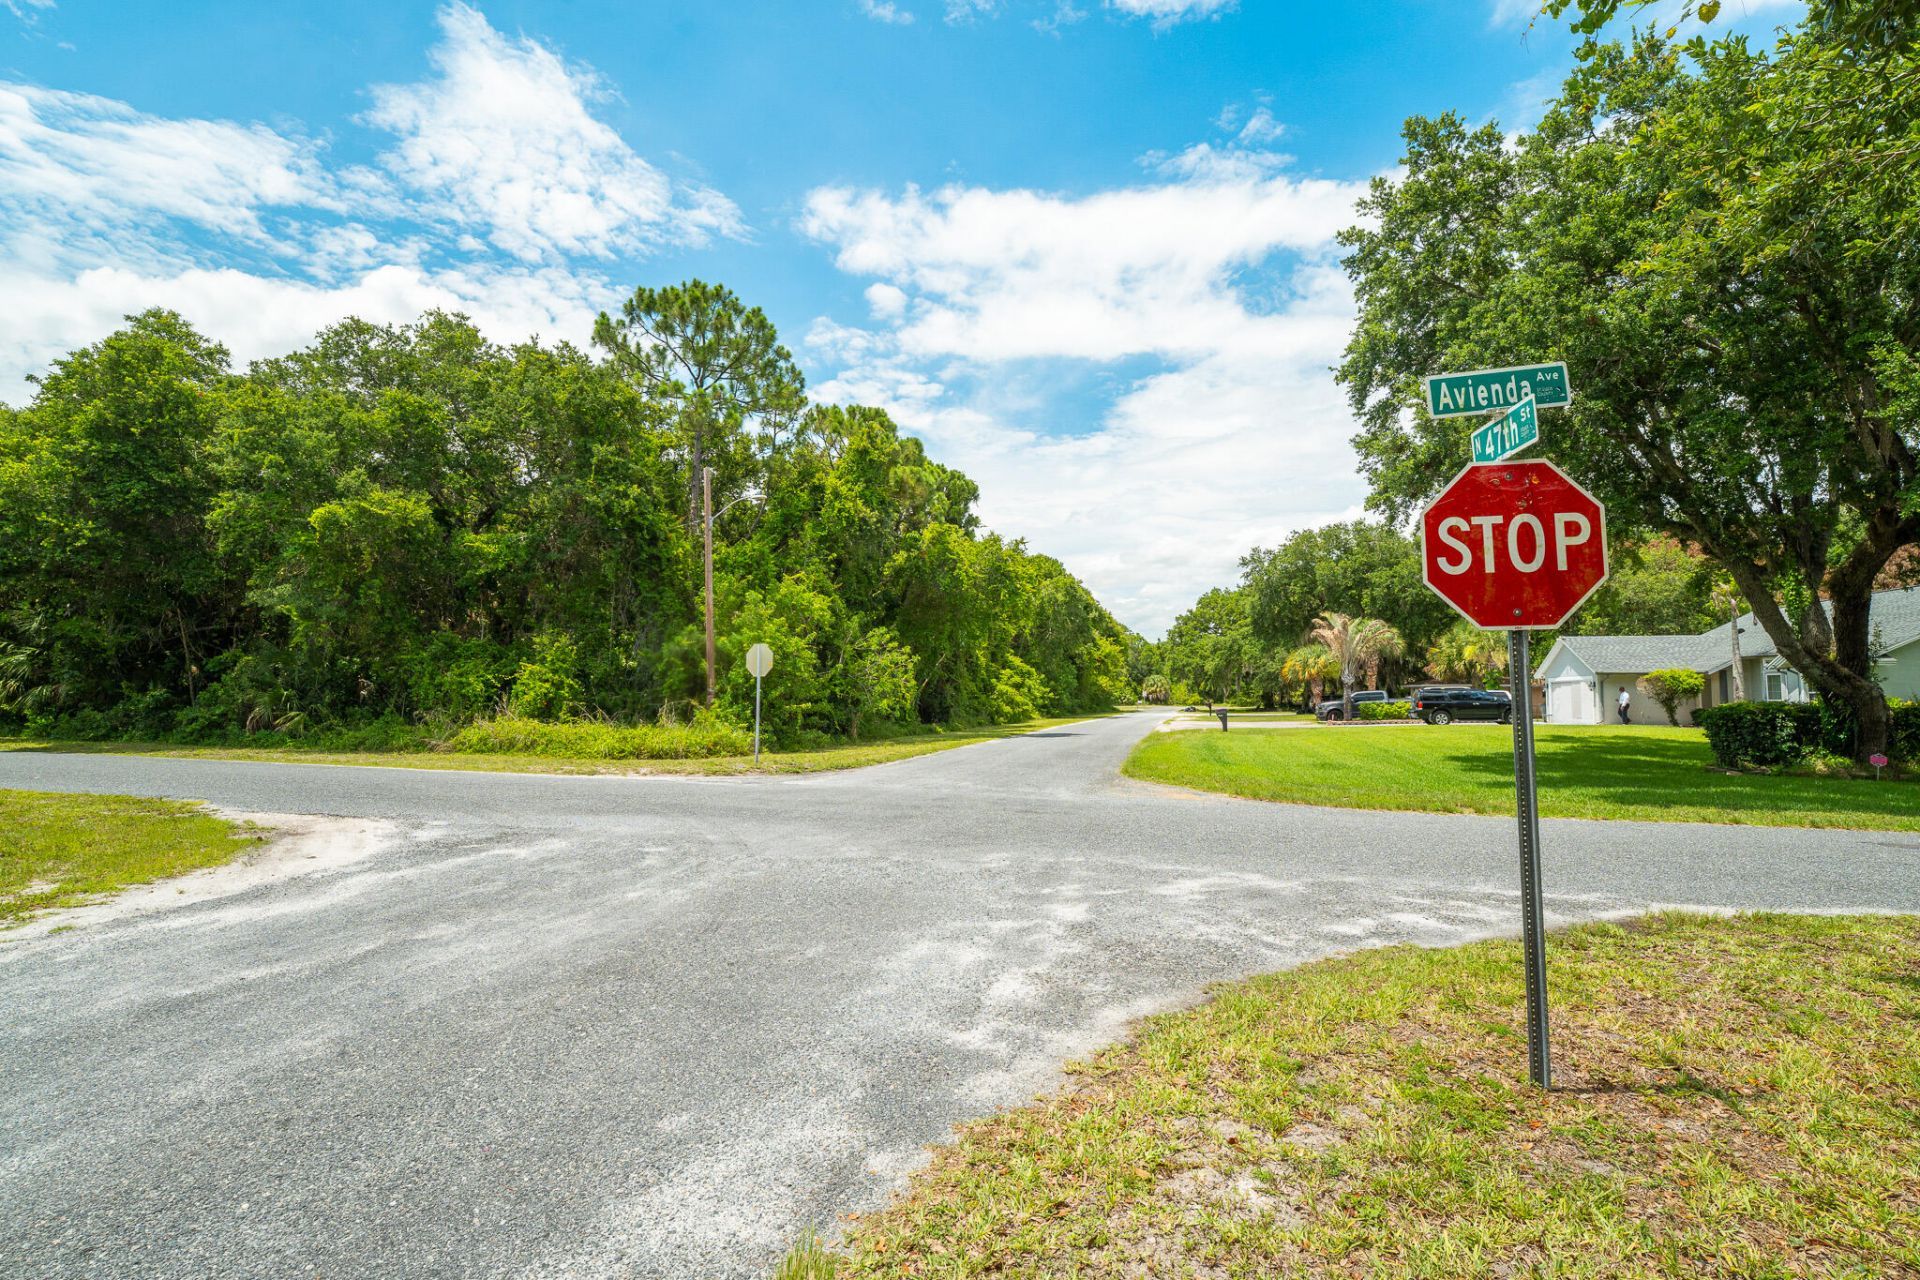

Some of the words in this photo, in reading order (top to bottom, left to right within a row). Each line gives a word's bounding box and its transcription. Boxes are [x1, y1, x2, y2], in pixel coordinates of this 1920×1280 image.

[1439, 374, 1532, 411] Avienda
[1536, 371, 1559, 382] Ave
[1474, 436, 1482, 455] N
[1485, 415, 1519, 458] 47th
[1520, 405, 1531, 422] St
[1436, 512, 1592, 576] STOP
